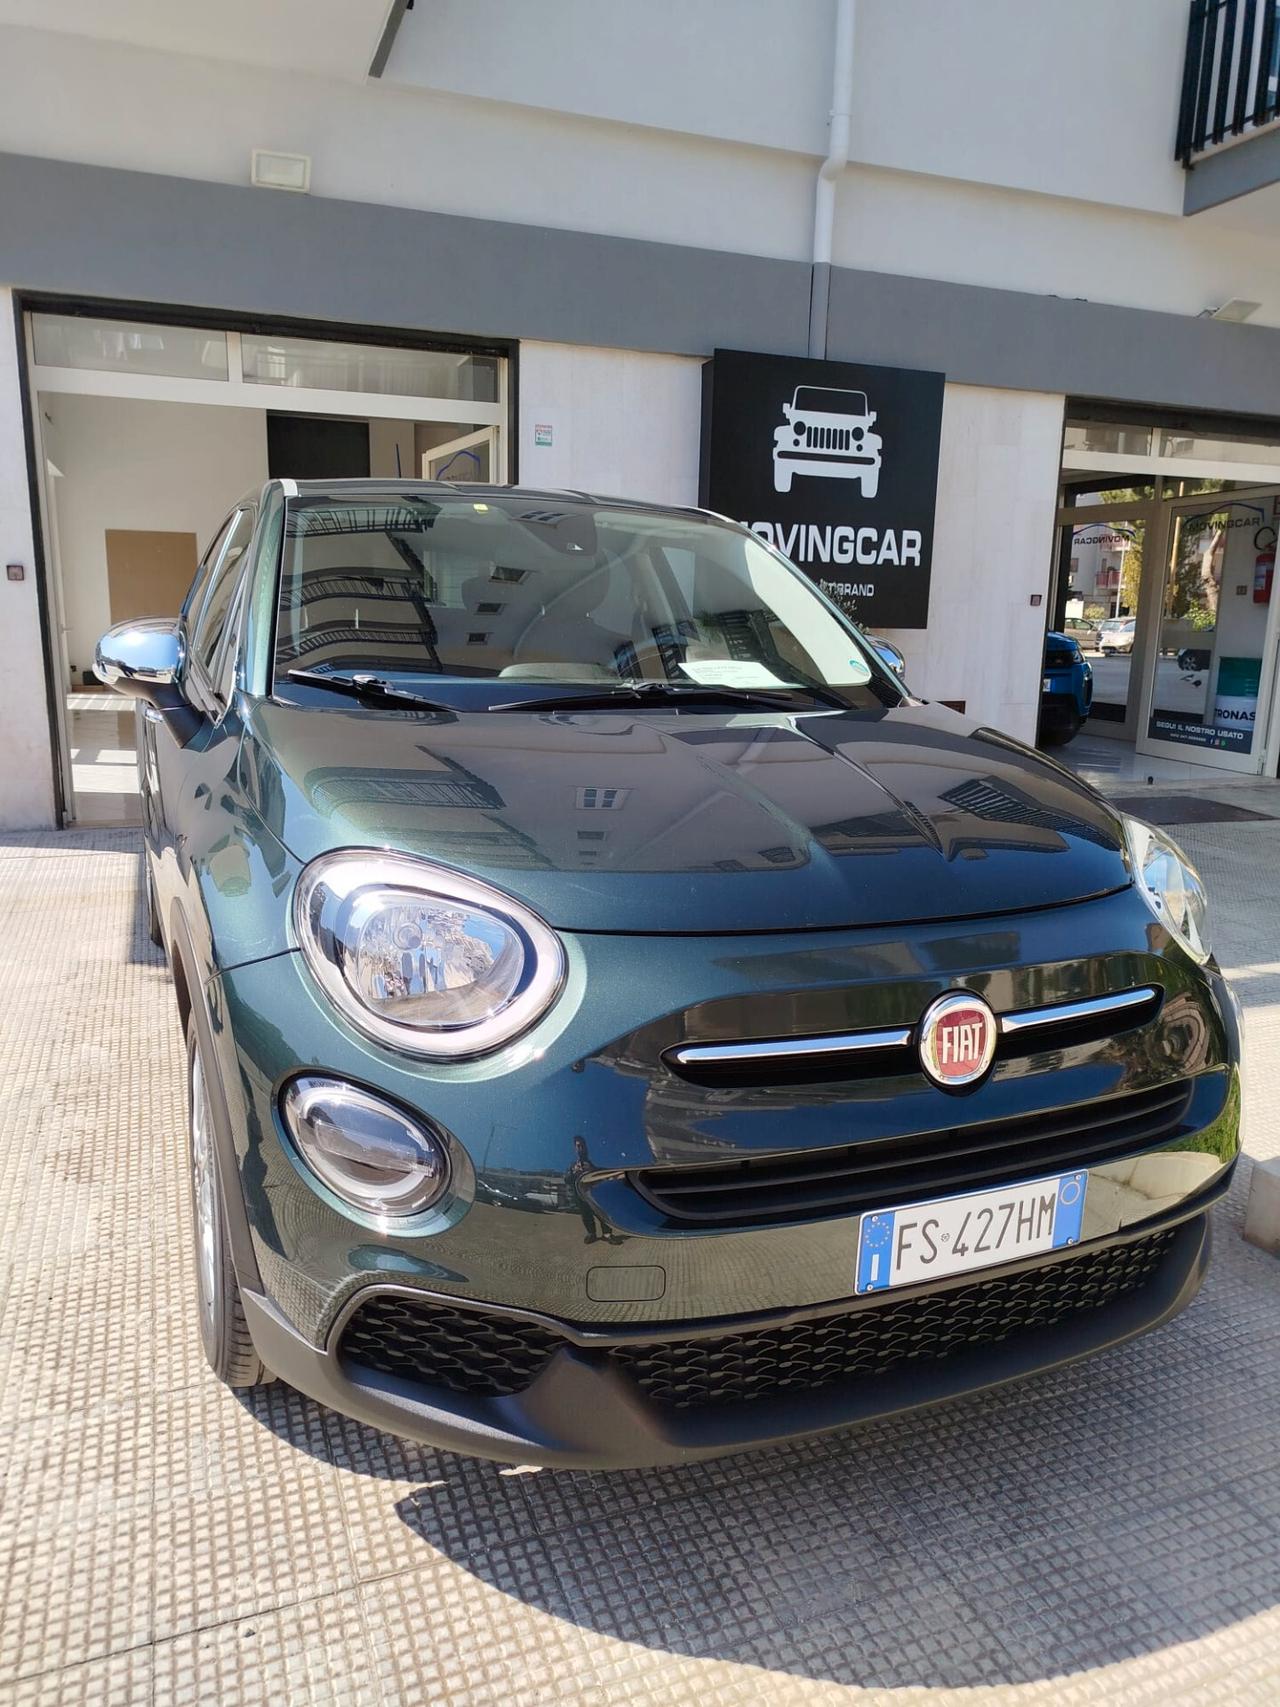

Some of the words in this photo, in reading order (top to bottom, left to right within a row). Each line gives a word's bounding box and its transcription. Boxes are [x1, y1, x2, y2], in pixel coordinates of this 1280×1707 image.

[740, 521, 922, 567] OVINGCAR
[1189, 517, 1261, 531] MOVINGCAR
[1185, 725, 1216, 736] NOSTRO
[1217, 730, 1244, 740] USATO
[942, 1022, 983, 1064] FIAT
[895, 1219, 940, 1270] FS
[952, 1192, 1056, 1257] 427HM
